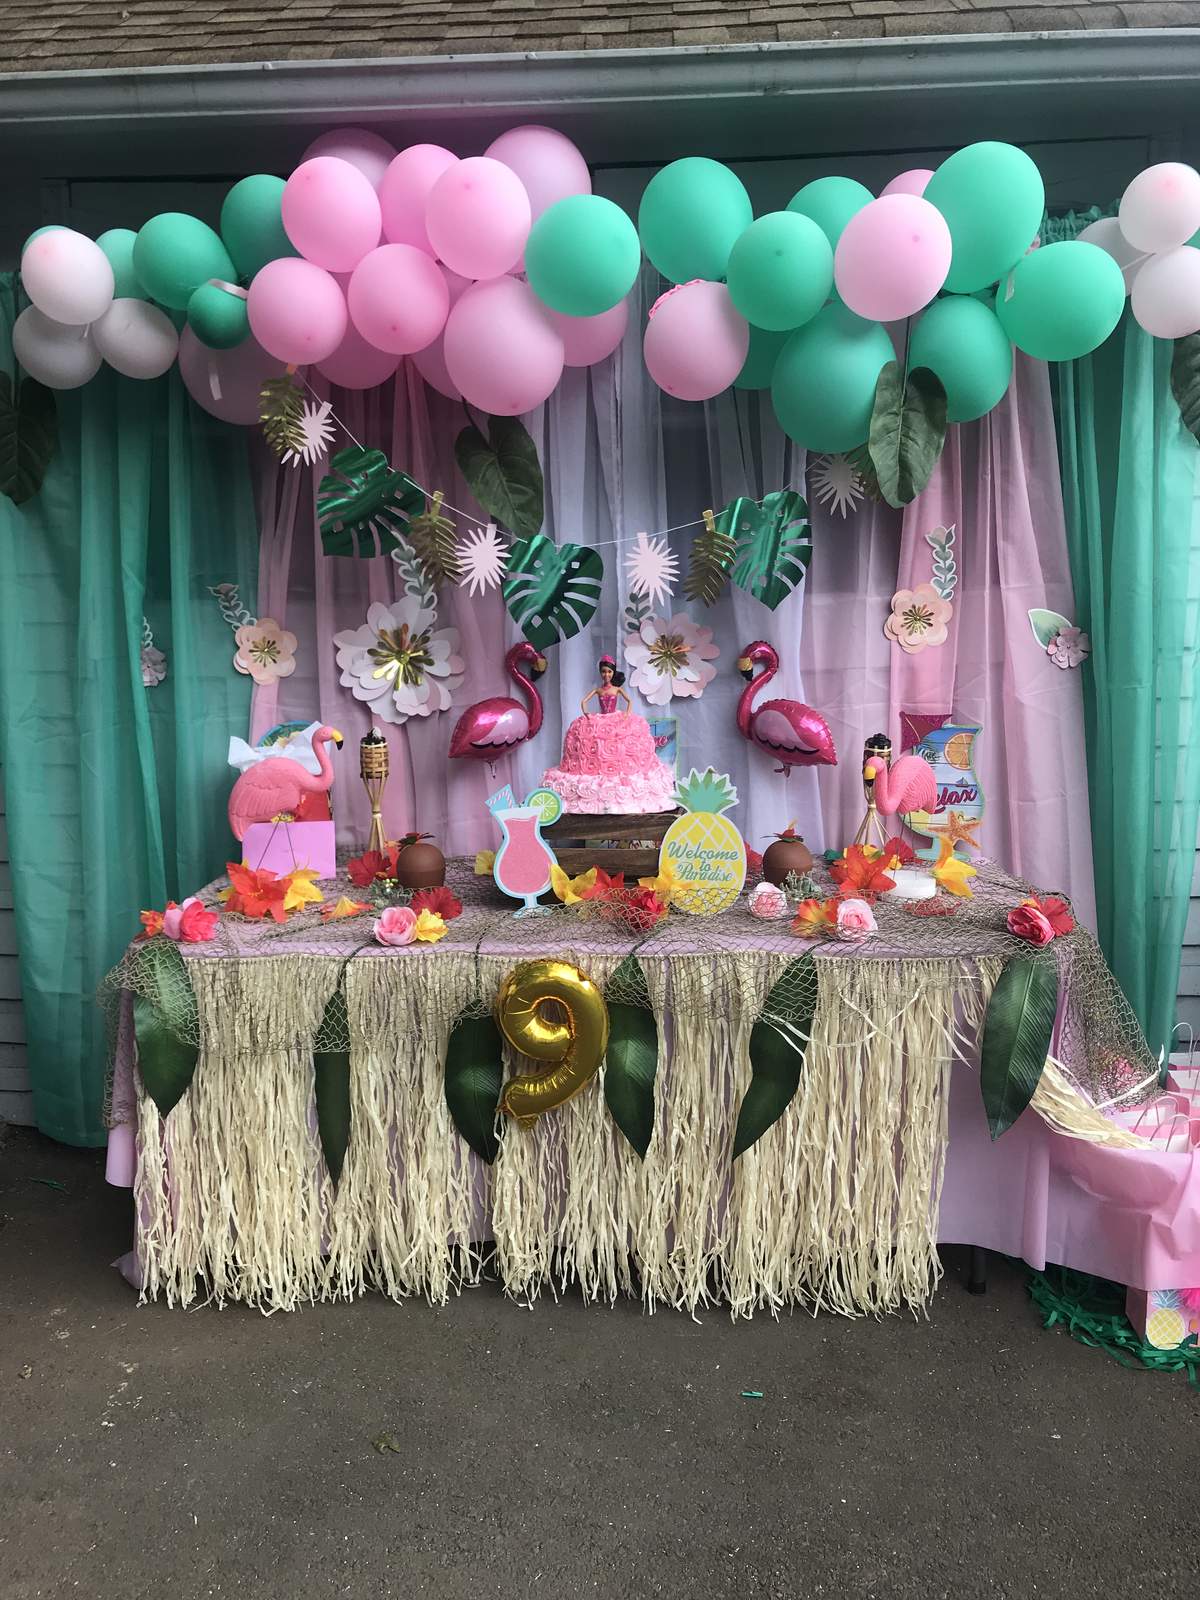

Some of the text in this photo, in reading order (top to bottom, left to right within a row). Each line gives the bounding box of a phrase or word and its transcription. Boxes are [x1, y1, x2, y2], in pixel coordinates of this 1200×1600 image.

[934, 786, 978, 815] lax
[668, 841, 738, 861] Welcome
[673, 861, 733, 882] Paradise
[699, 858, 711, 872] to
[494, 958, 610, 1123] 9
